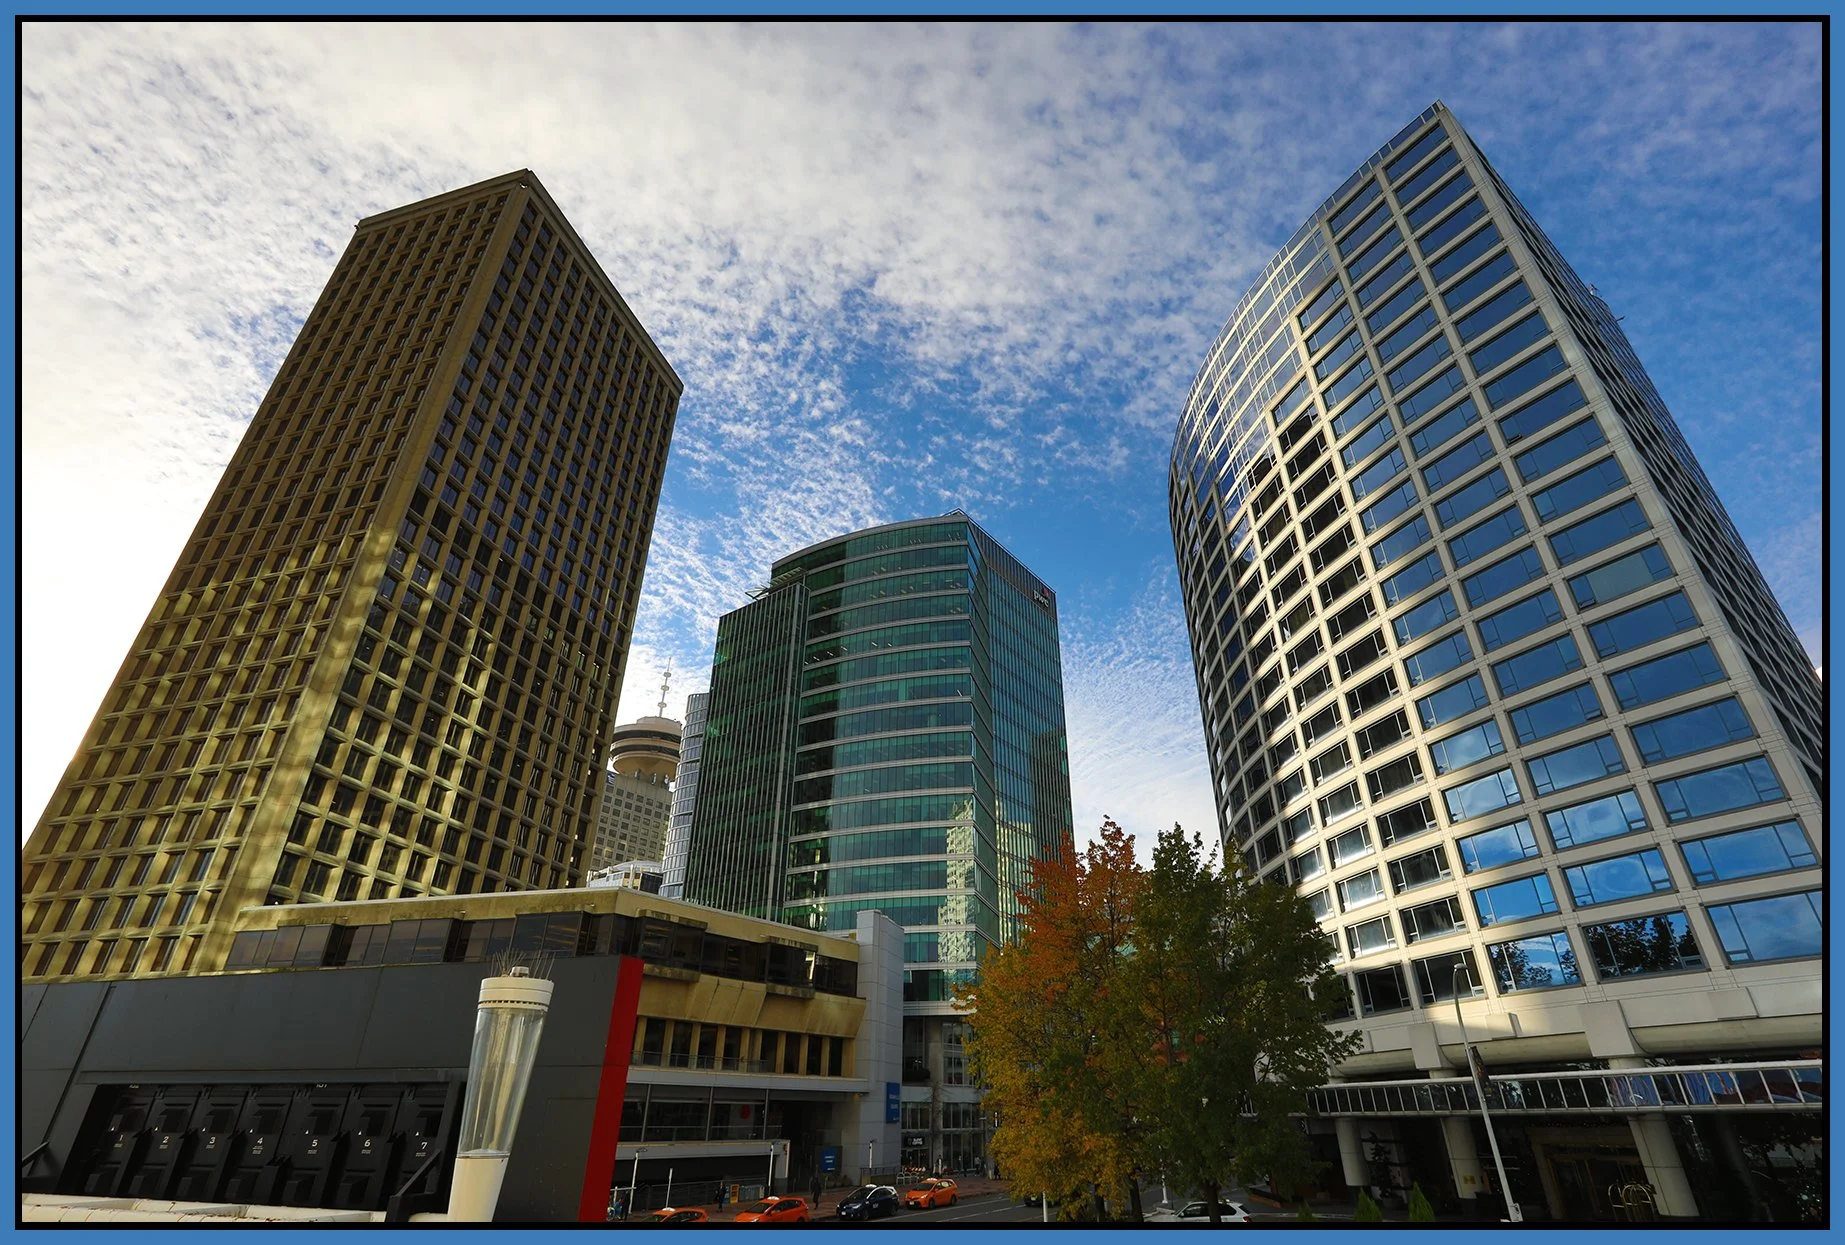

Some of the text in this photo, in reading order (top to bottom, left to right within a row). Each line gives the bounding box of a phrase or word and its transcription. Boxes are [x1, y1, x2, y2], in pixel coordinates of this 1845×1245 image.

[1033, 590, 1049, 608] pwc
[162, 1135, 170, 1144] 2
[209, 1136, 216, 1144] 3
[257, 1137, 264, 1145] 4
[311, 1139, 319, 1147] 5
[364, 1138, 371, 1147] 6
[421, 1141, 428, 1150] 7
